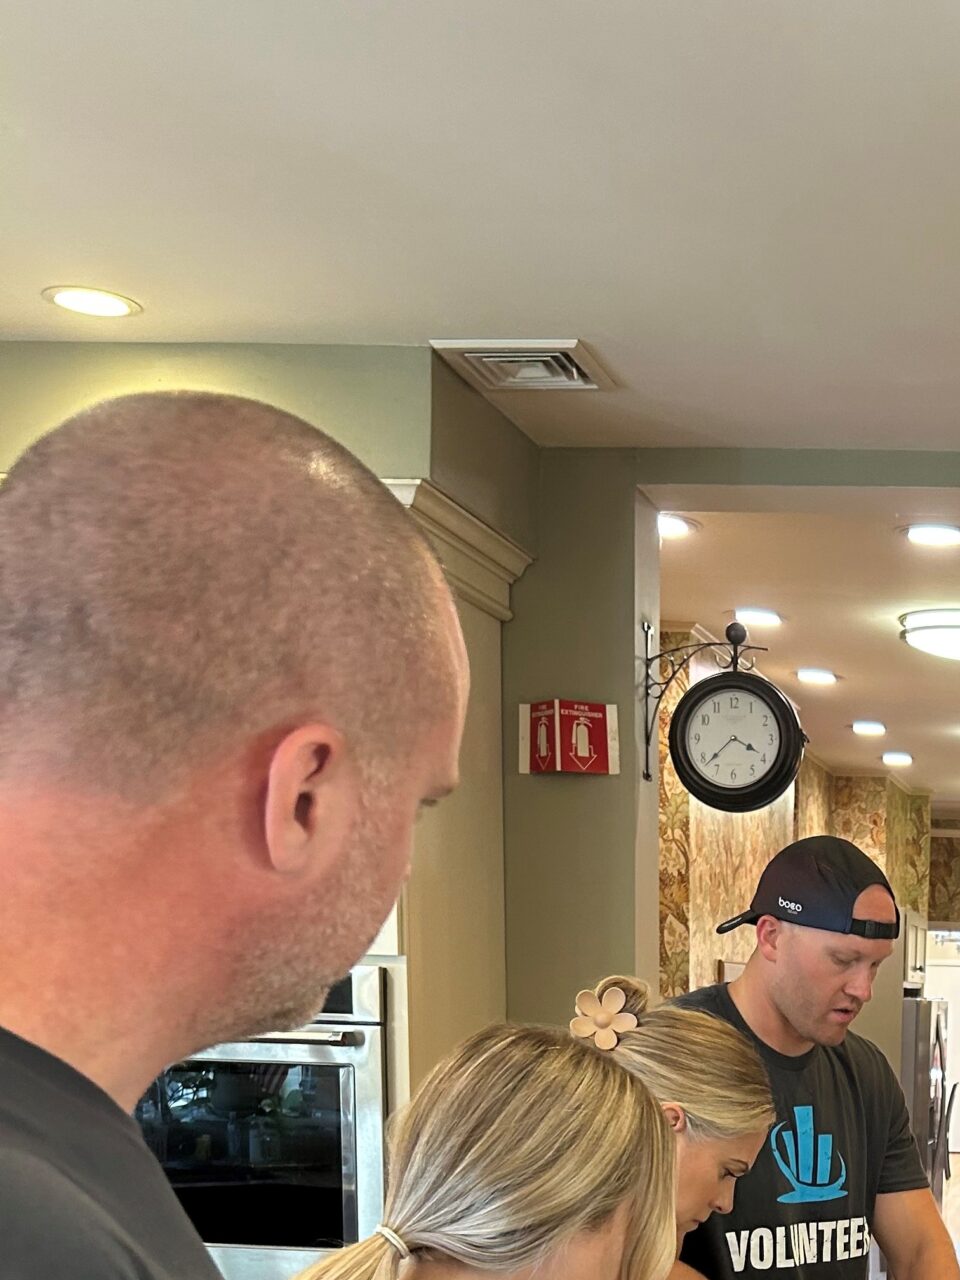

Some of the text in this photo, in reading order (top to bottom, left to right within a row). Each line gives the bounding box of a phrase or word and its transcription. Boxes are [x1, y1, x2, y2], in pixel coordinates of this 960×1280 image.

[713, 701, 720, 714] 11
[729, 697, 739, 709] 12
[701, 714, 710, 726] 10
[762, 715, 768, 727] 2
[694, 733, 700, 744] 9
[768, 733, 774, 745] 3
[700, 752, 706, 764] 8
[760, 753, 766, 764] 4
[714, 764, 720, 776] 7
[730, 768, 737, 780] 6
[749, 764, 755, 776] 5
